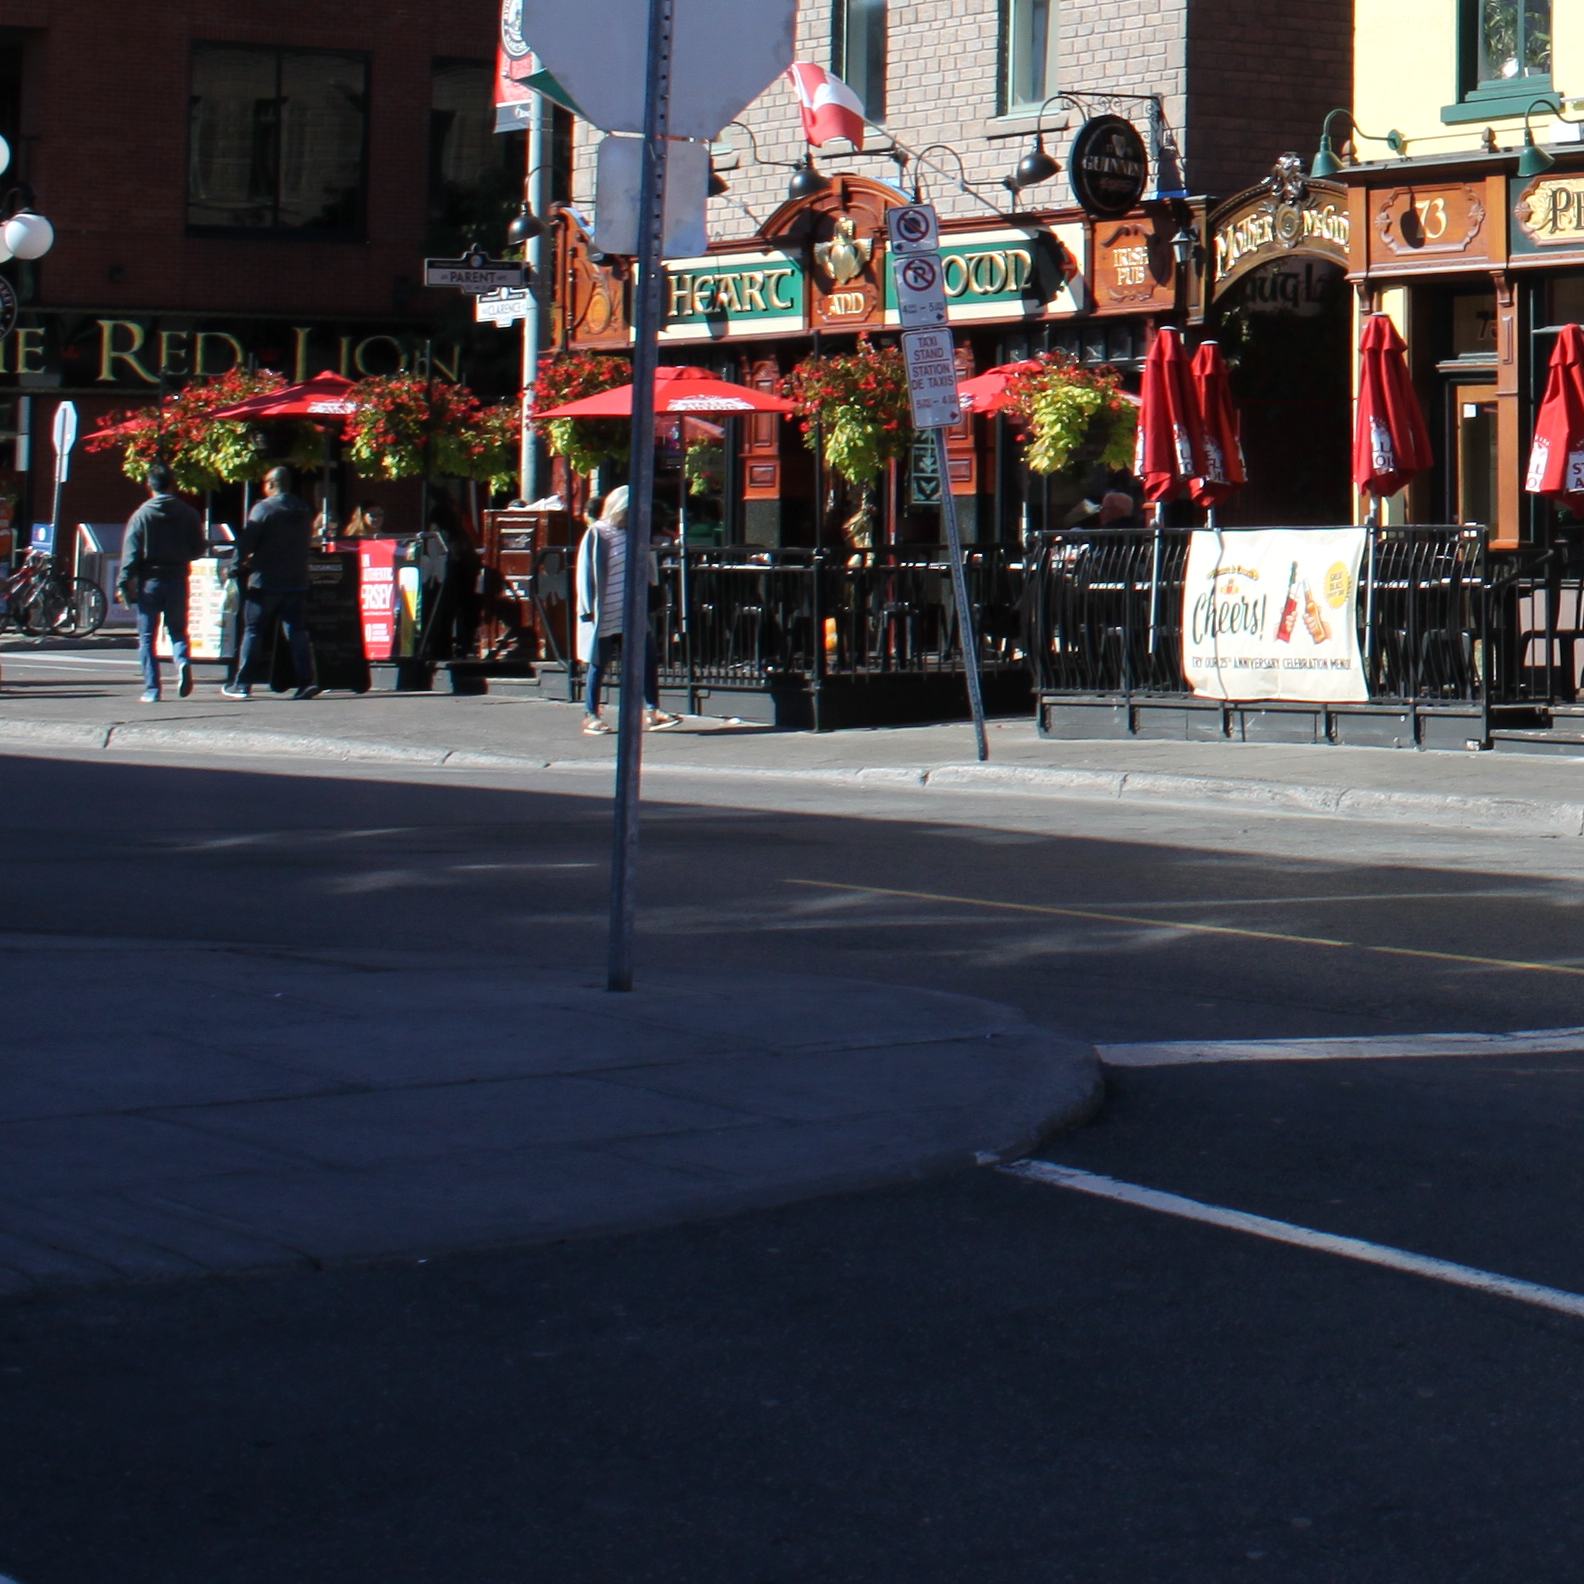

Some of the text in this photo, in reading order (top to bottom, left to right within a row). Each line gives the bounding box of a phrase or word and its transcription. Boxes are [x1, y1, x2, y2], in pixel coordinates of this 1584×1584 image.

[1415, 196, 1449, 239] 73
[450, 271, 497, 283] PARENT
[941, 249, 1032, 297] OWN
[1117, 267, 1145, 286] PUB
[667, 268, 794, 317] HEART
[917, 336, 938, 348] TAXI
[914, 347, 944, 361] STAND
[912, 363, 951, 378] STATION
[911, 376, 954, 391] DE TAXIS
[361, 583, 394, 609] ERSEY
[1192, 582, 1267, 645] Cheers!
[1282, 657, 1328, 670] CELEBRATION
